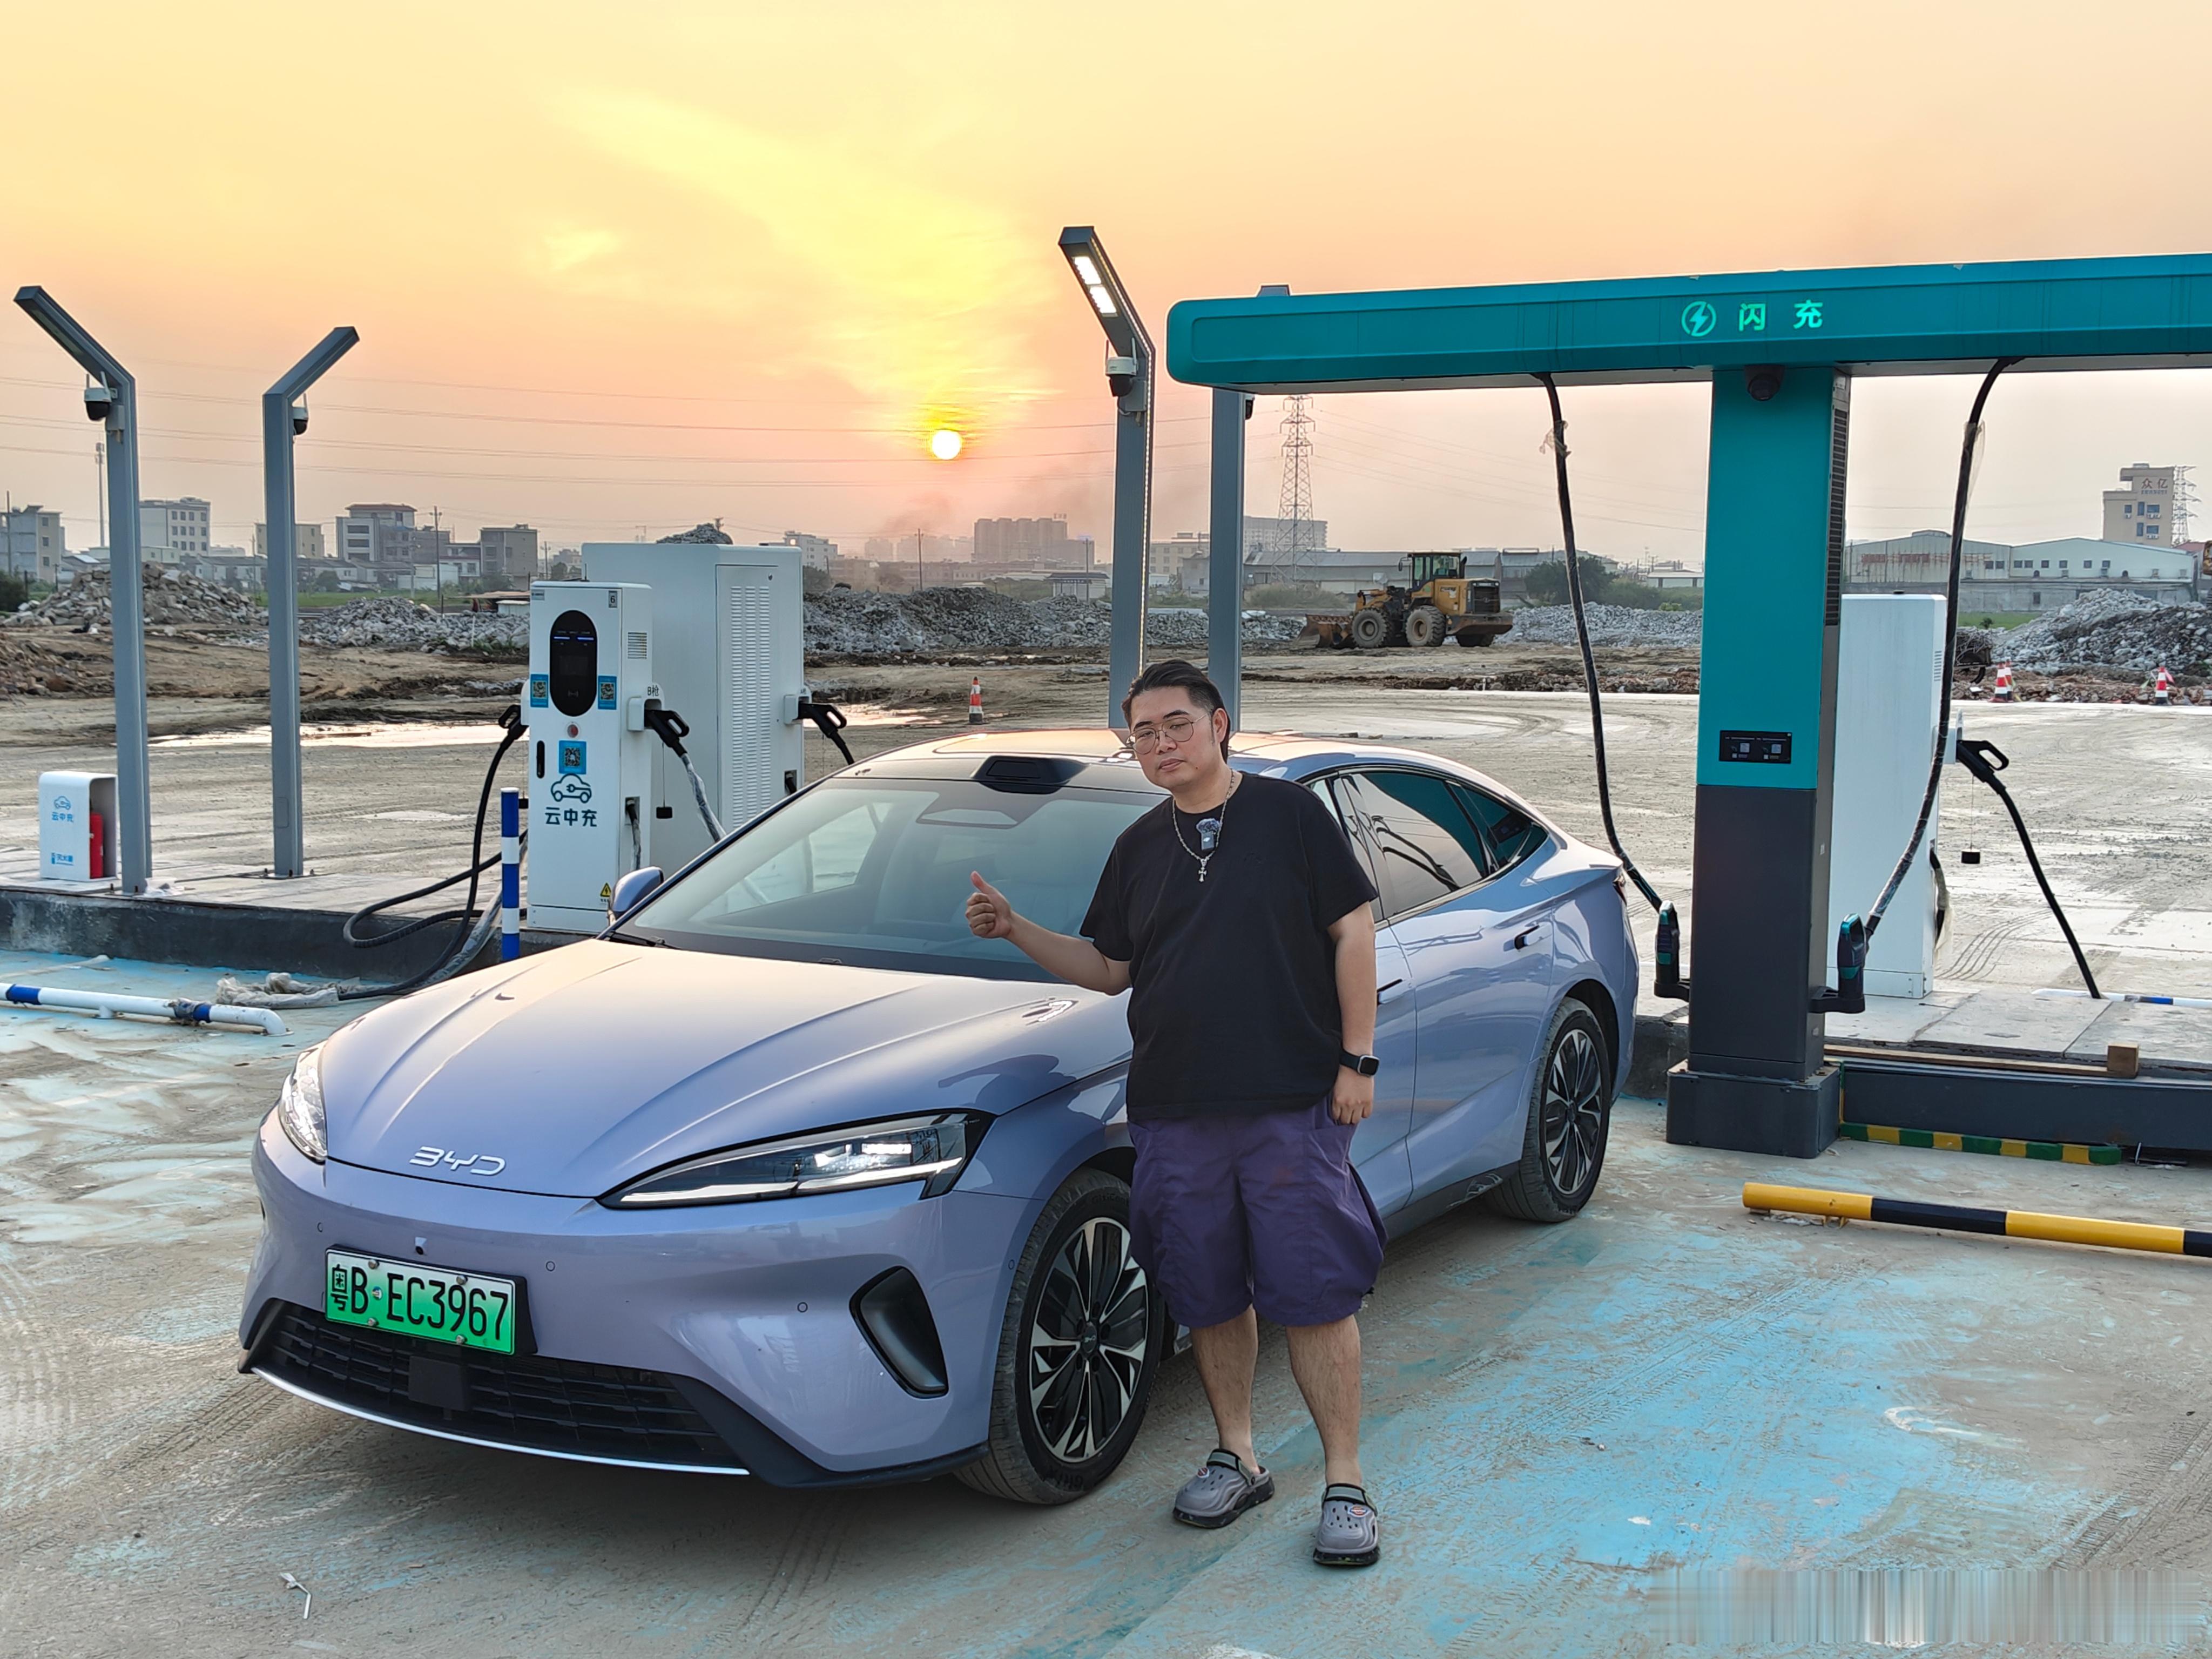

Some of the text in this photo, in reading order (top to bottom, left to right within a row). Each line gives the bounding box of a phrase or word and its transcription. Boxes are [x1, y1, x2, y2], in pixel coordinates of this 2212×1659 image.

[1738, 299, 1823, 332] 闪充
[2141, 478, 2168, 489] 众亿
[648, 685, 659, 697] B枪
[545, 807, 597, 827] 云中充
[409, 1146, 506, 1176] BYD
